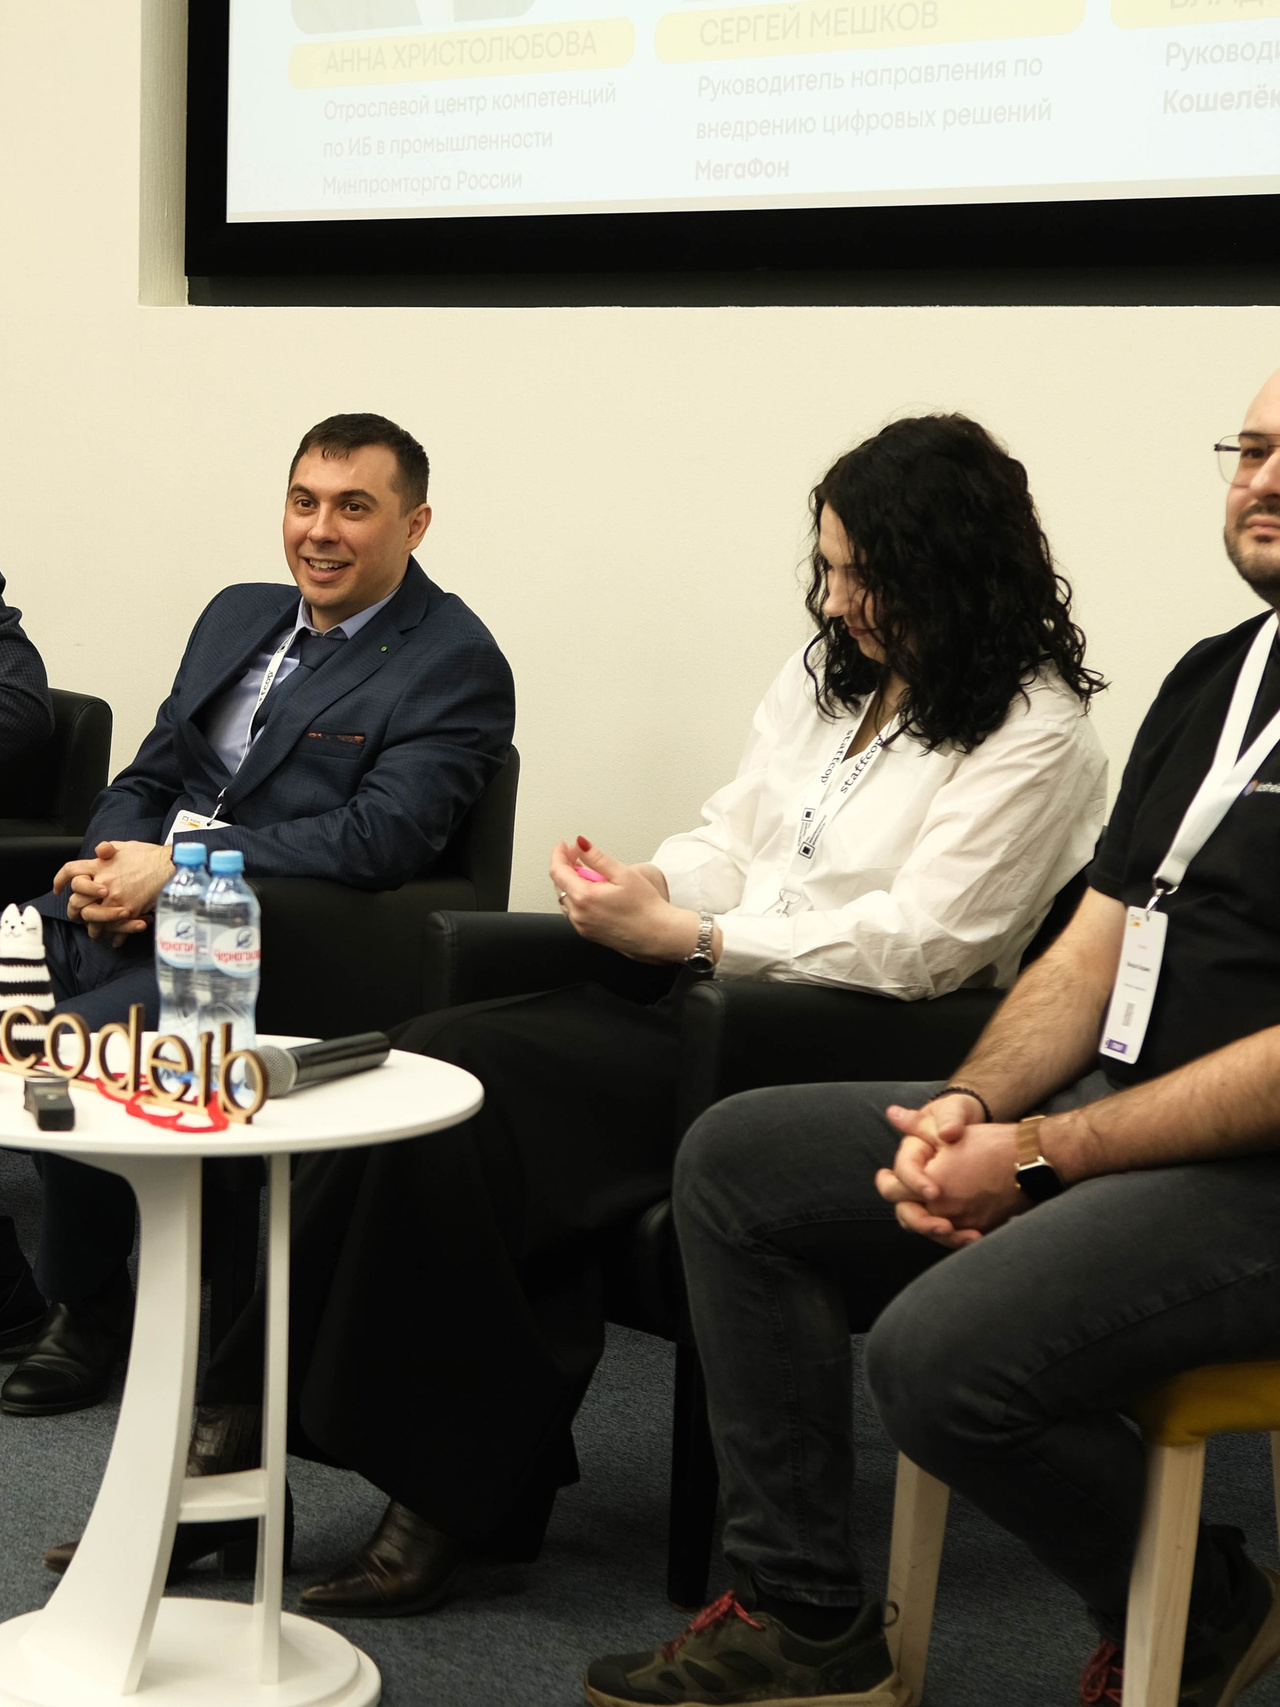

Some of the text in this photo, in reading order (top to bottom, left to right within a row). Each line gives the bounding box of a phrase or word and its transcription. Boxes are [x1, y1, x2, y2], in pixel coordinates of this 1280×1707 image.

[699, 0, 939, 47] СЕРГЕЙ МЕШКОВ
[324, 28, 598, 76] АННА ХРИСТОЛЮБОВА
[697, 56, 1044, 102] Руководитель направления по
[323, 82, 617, 123] Отраслевой центр компетенций
[696, 97, 1053, 142] внедрению цифровых решений
[323, 130, 554, 159] по ИБ в промышленности
[322, 169, 523, 198] Минпромторга России
[694, 156, 791, 182] МегаФон
[840, 734, 885, 794] staffcop
